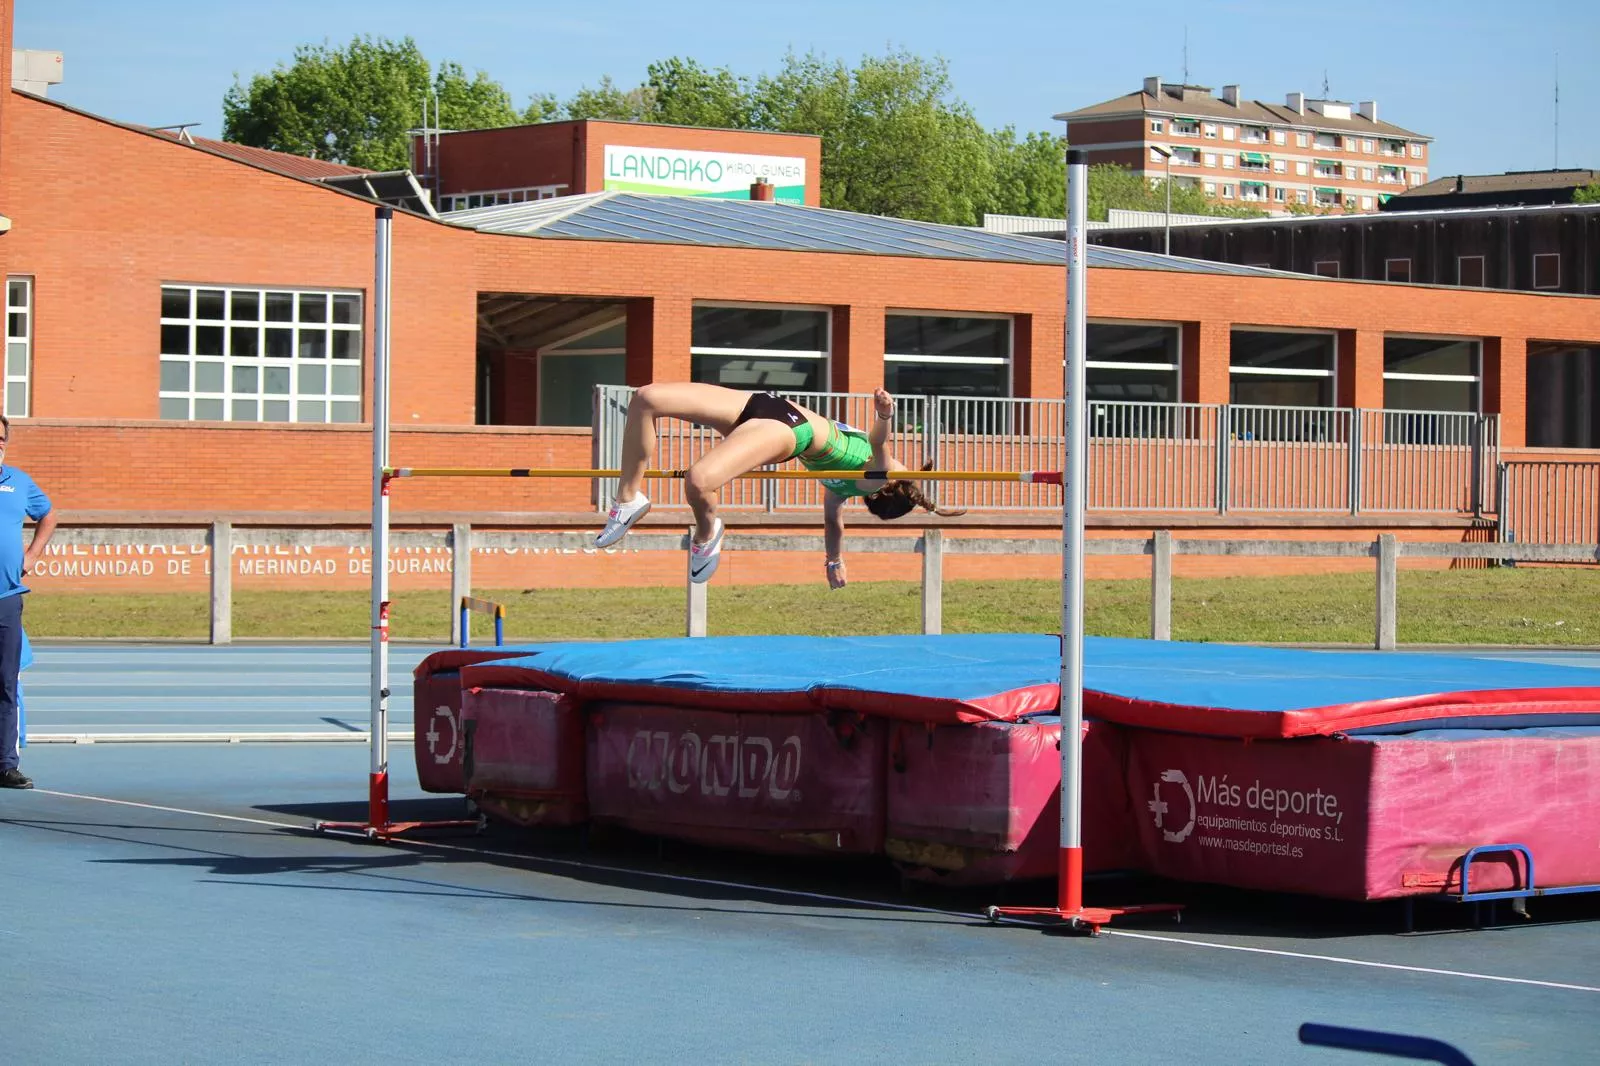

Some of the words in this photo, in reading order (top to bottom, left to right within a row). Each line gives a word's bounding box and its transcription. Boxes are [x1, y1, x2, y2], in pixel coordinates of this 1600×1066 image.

[610, 153, 723, 183] LANDAKO
[760, 164, 801, 178] GUNEA
[27, 560, 154, 576] COMUNIDAD
[167, 560, 190, 575] DE
[239, 559, 337, 575] MERINDAD
[349, 559, 372, 574] DE
[387, 558, 453, 573] DURAN
[627, 730, 802, 800] MONDO
[1197, 774, 1241, 807] Más
[1246, 779, 1344, 825] deporte,
[1197, 814, 1267, 834] equipamientos
[1270, 820, 1321, 839] deportivos
[1324, 826, 1344, 842] S.L.
[1198, 835, 1304, 858] www.masdeportesl.es
